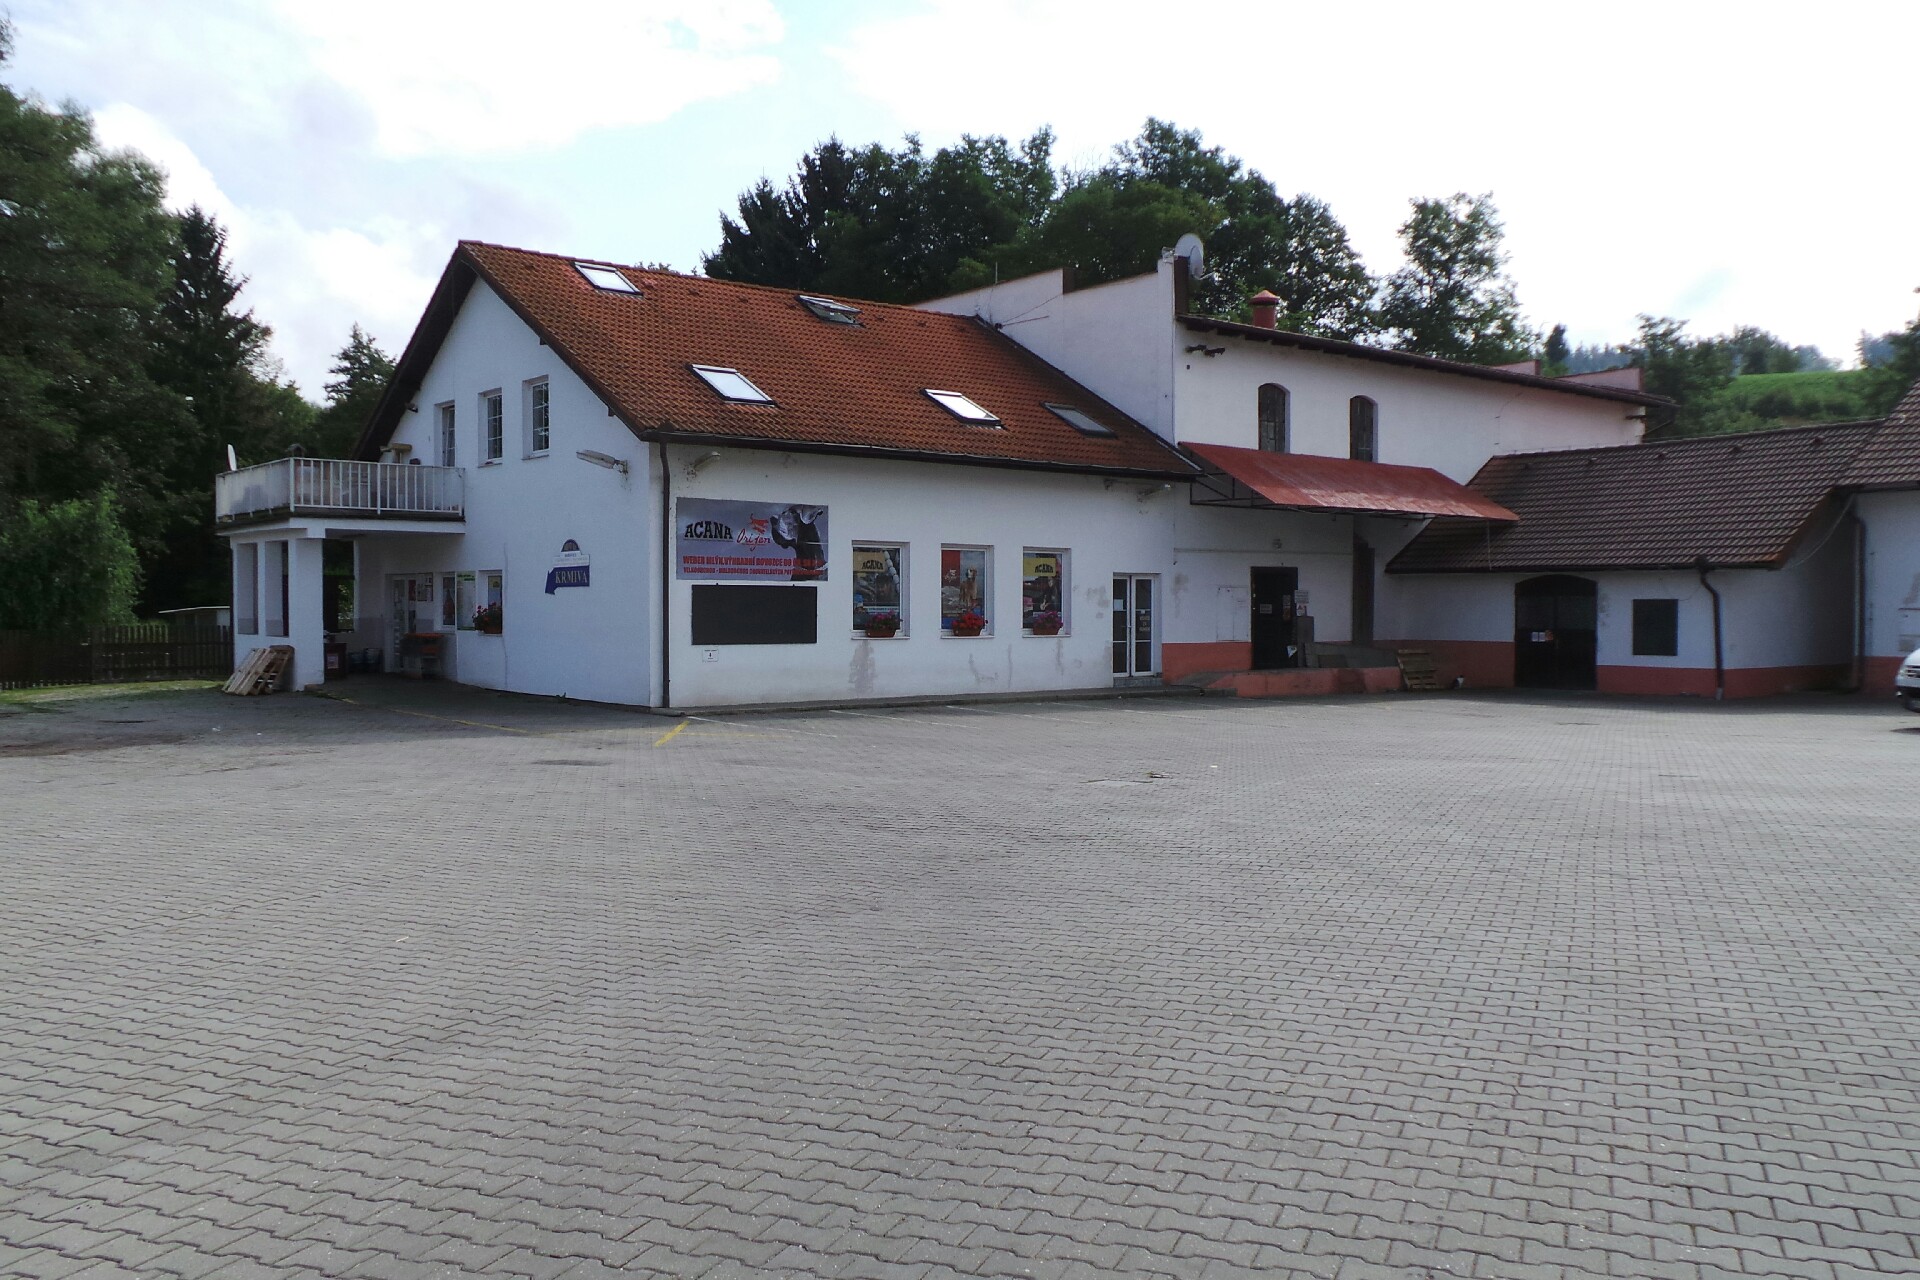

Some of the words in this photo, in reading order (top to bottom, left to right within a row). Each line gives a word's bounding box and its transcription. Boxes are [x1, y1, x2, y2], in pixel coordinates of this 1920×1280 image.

[684, 520, 732, 539] ACANA
[861, 559, 884, 570] ACANA
[1034, 563, 1054, 573] ACANA
[555, 570, 588, 584] KRMIVA
